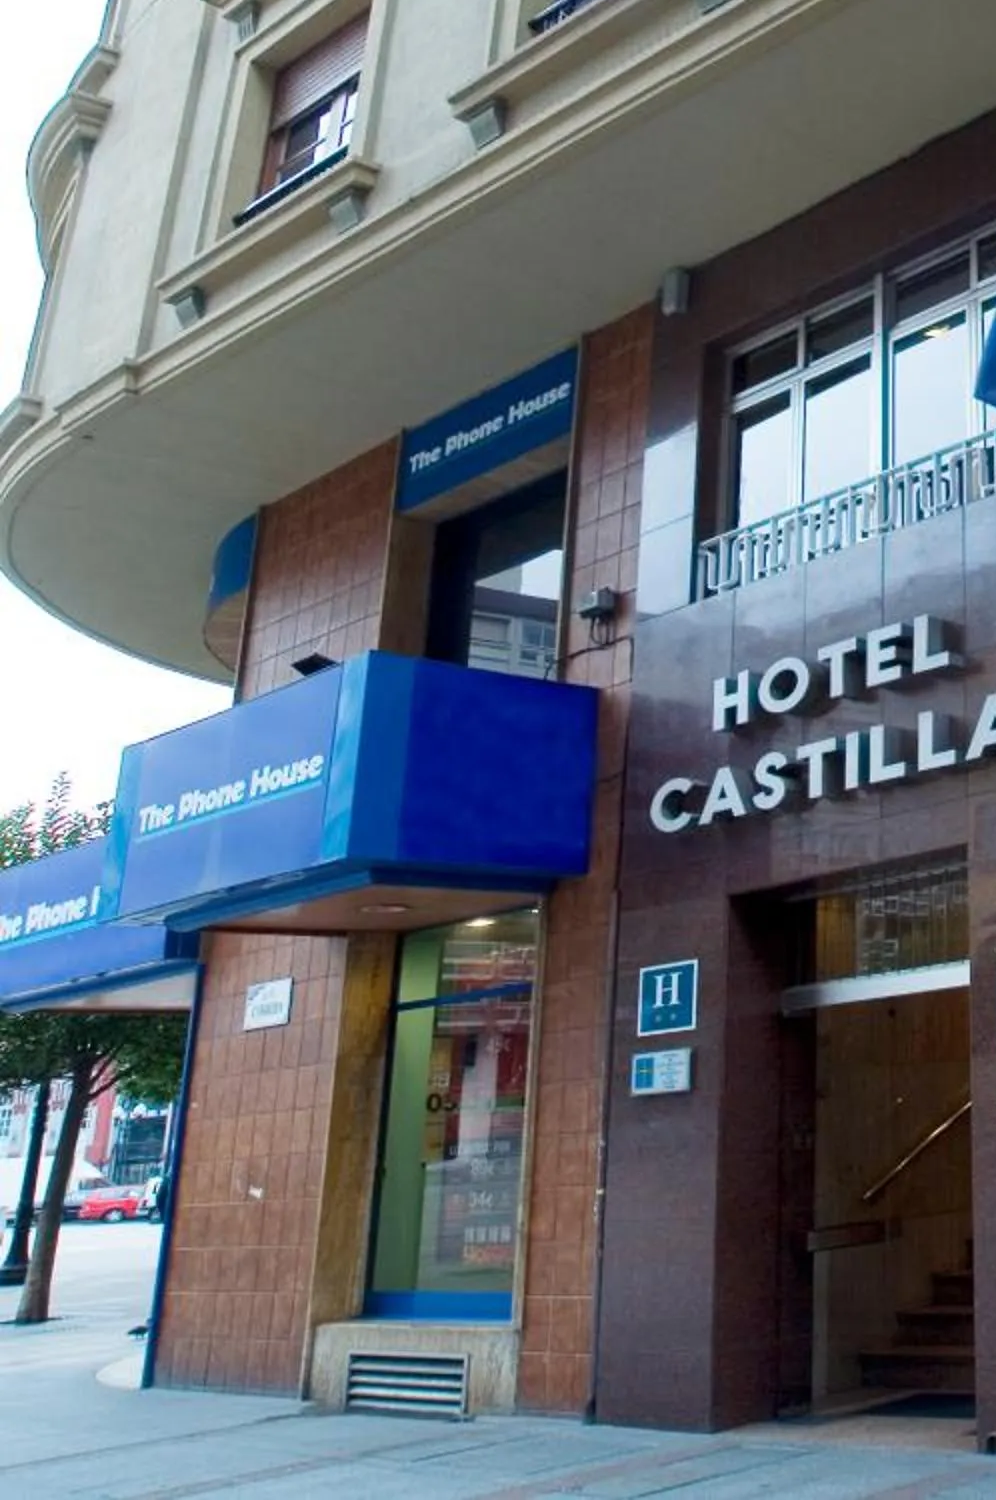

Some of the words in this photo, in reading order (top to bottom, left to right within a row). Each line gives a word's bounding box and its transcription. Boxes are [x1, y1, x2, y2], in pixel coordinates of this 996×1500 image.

[409, 446, 442, 474] The
[444, 414, 504, 456] Phone
[507, 382, 572, 425] House
[712, 613, 956, 733] HOTEL
[139, 800, 175, 834] The
[177, 776, 246, 822] Phone
[250, 754, 325, 798] House
[0, 914, 23, 942] he
[25, 896, 89, 935] Phone
[652, 971, 684, 1009] H
